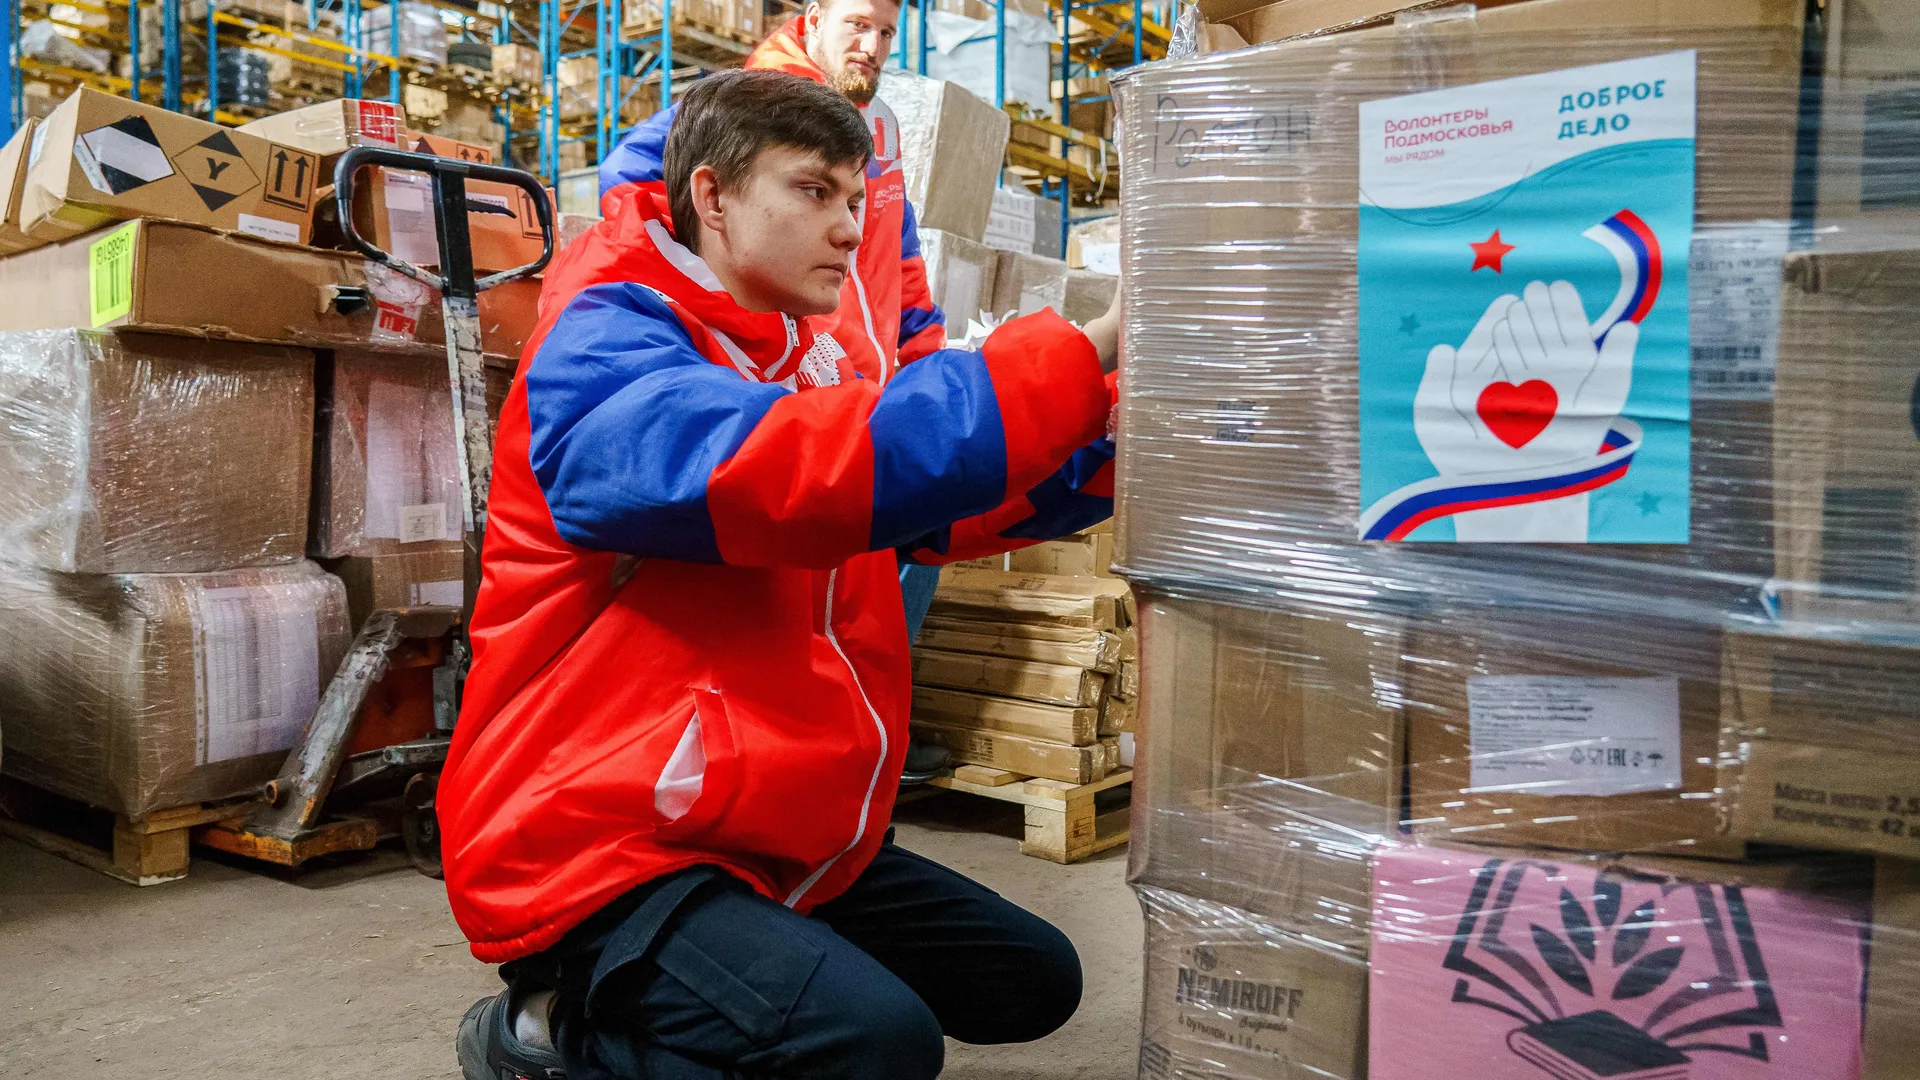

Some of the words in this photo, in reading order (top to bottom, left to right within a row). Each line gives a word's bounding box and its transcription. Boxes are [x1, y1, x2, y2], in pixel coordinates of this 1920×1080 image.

[1559, 79, 1666, 113] ДОБРОЕ
[1558, 113, 1630, 141] ДЕЛО
[206, 156, 231, 181] Y
[1880, 818, 1905, 836] 42
